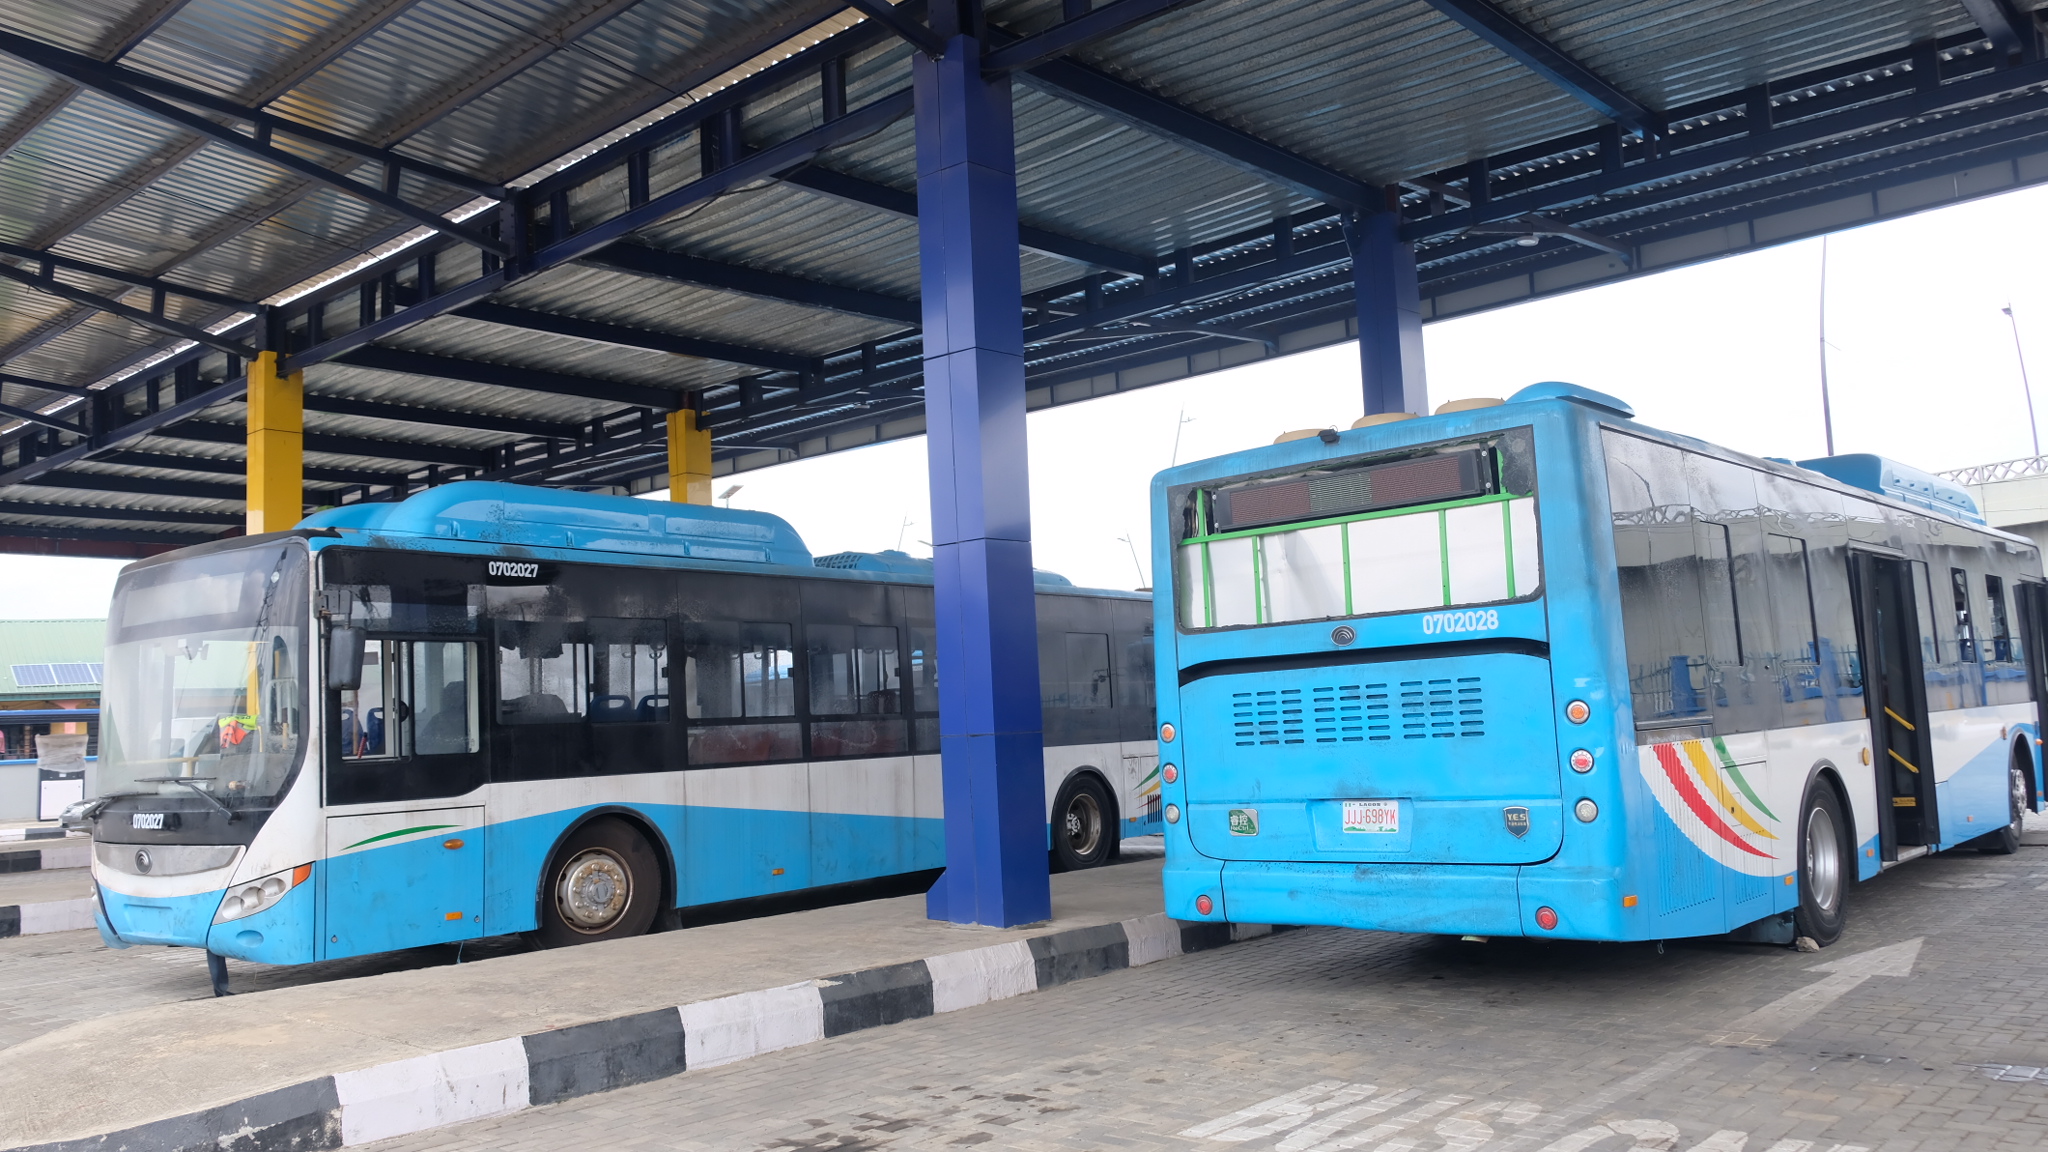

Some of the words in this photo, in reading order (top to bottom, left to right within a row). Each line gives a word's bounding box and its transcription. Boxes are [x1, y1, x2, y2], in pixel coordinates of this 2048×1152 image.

[489, 561, 538, 578] 0702027
[1423, 609, 1499, 635] 0702028
[132, 813, 164, 829] 0702027
